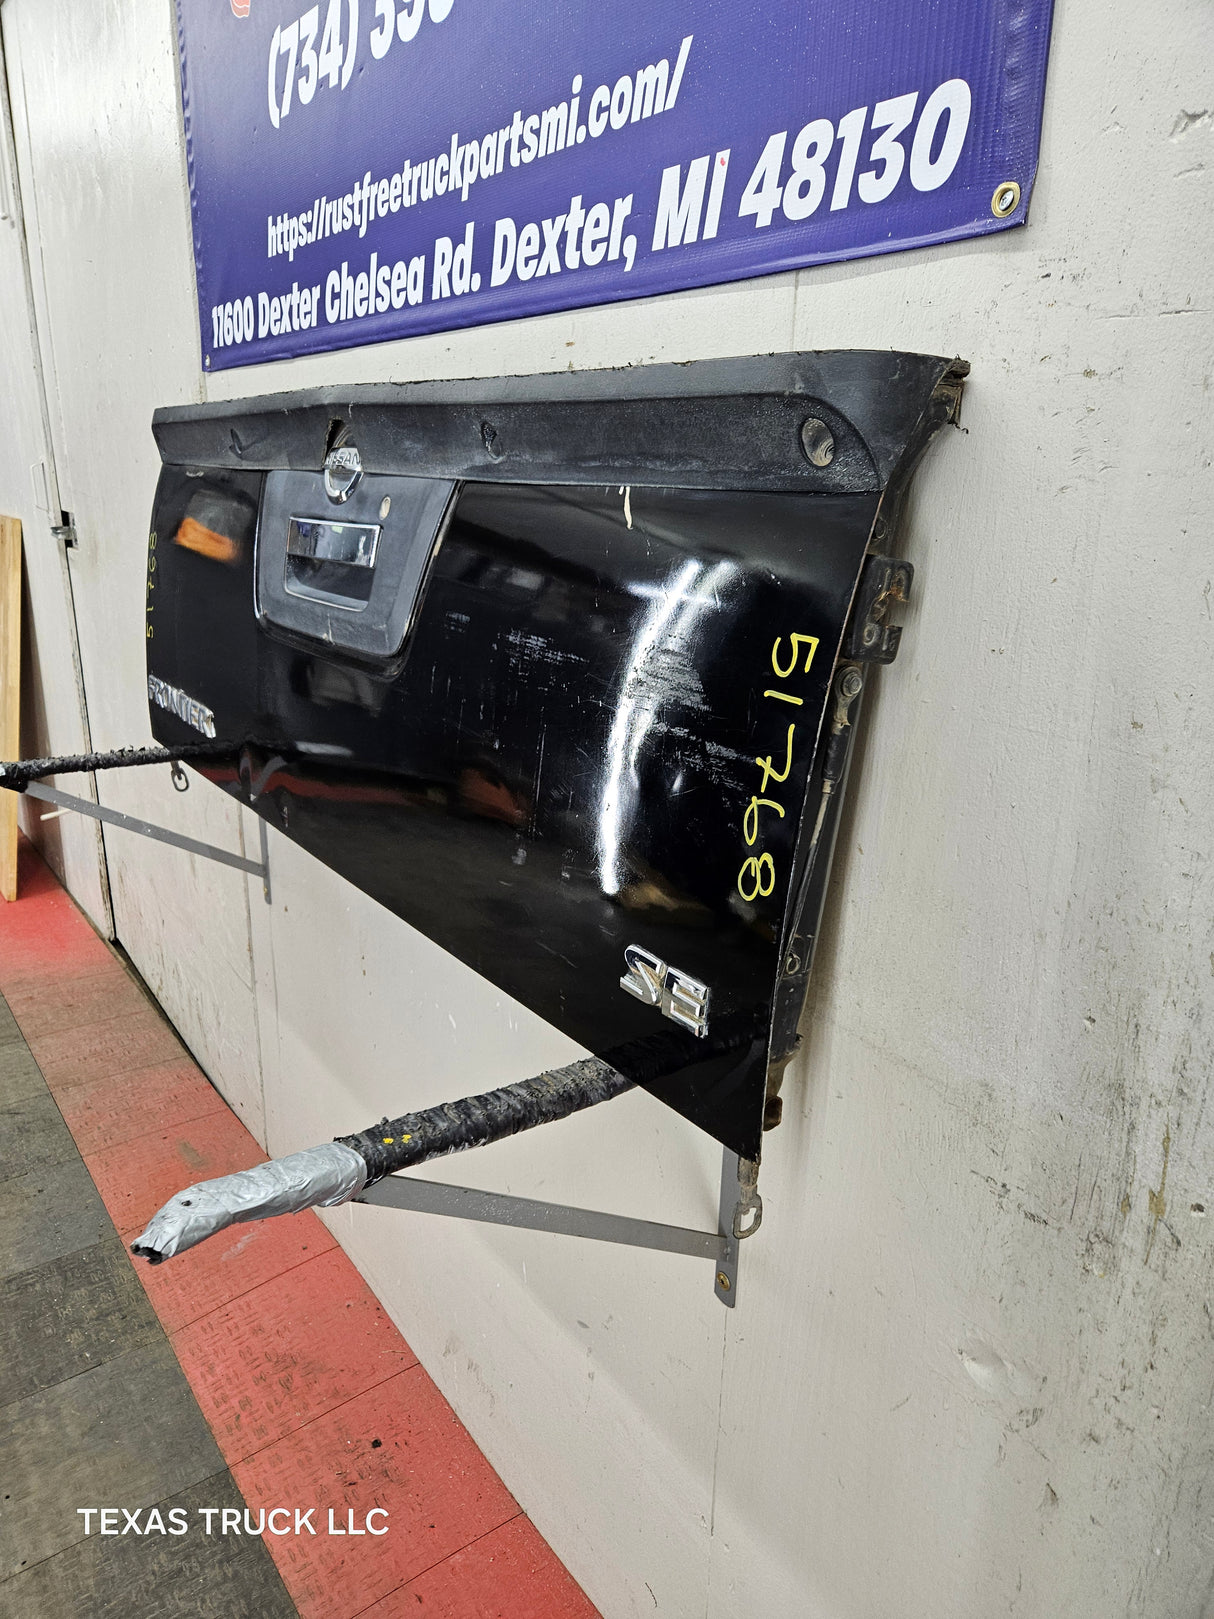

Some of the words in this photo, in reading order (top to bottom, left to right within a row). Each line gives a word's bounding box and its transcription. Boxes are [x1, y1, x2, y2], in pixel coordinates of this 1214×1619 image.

[267, 35, 694, 262] https://rustfreetruckpartsmi.com/
[268, 0, 358, 129] (734)
[211, 296, 254, 348] 11600
[257, 282, 320, 338] Dexter
[324, 252, 425, 324] Chelsea
[431, 222, 481, 301] Rd.
[489, 193, 637, 287] Dexter,
[651, 149, 731, 252] MI
[738, 78, 973, 228] 48130
[738, 632, 820, 902] 51768
[619, 943, 711, 1039] SE
